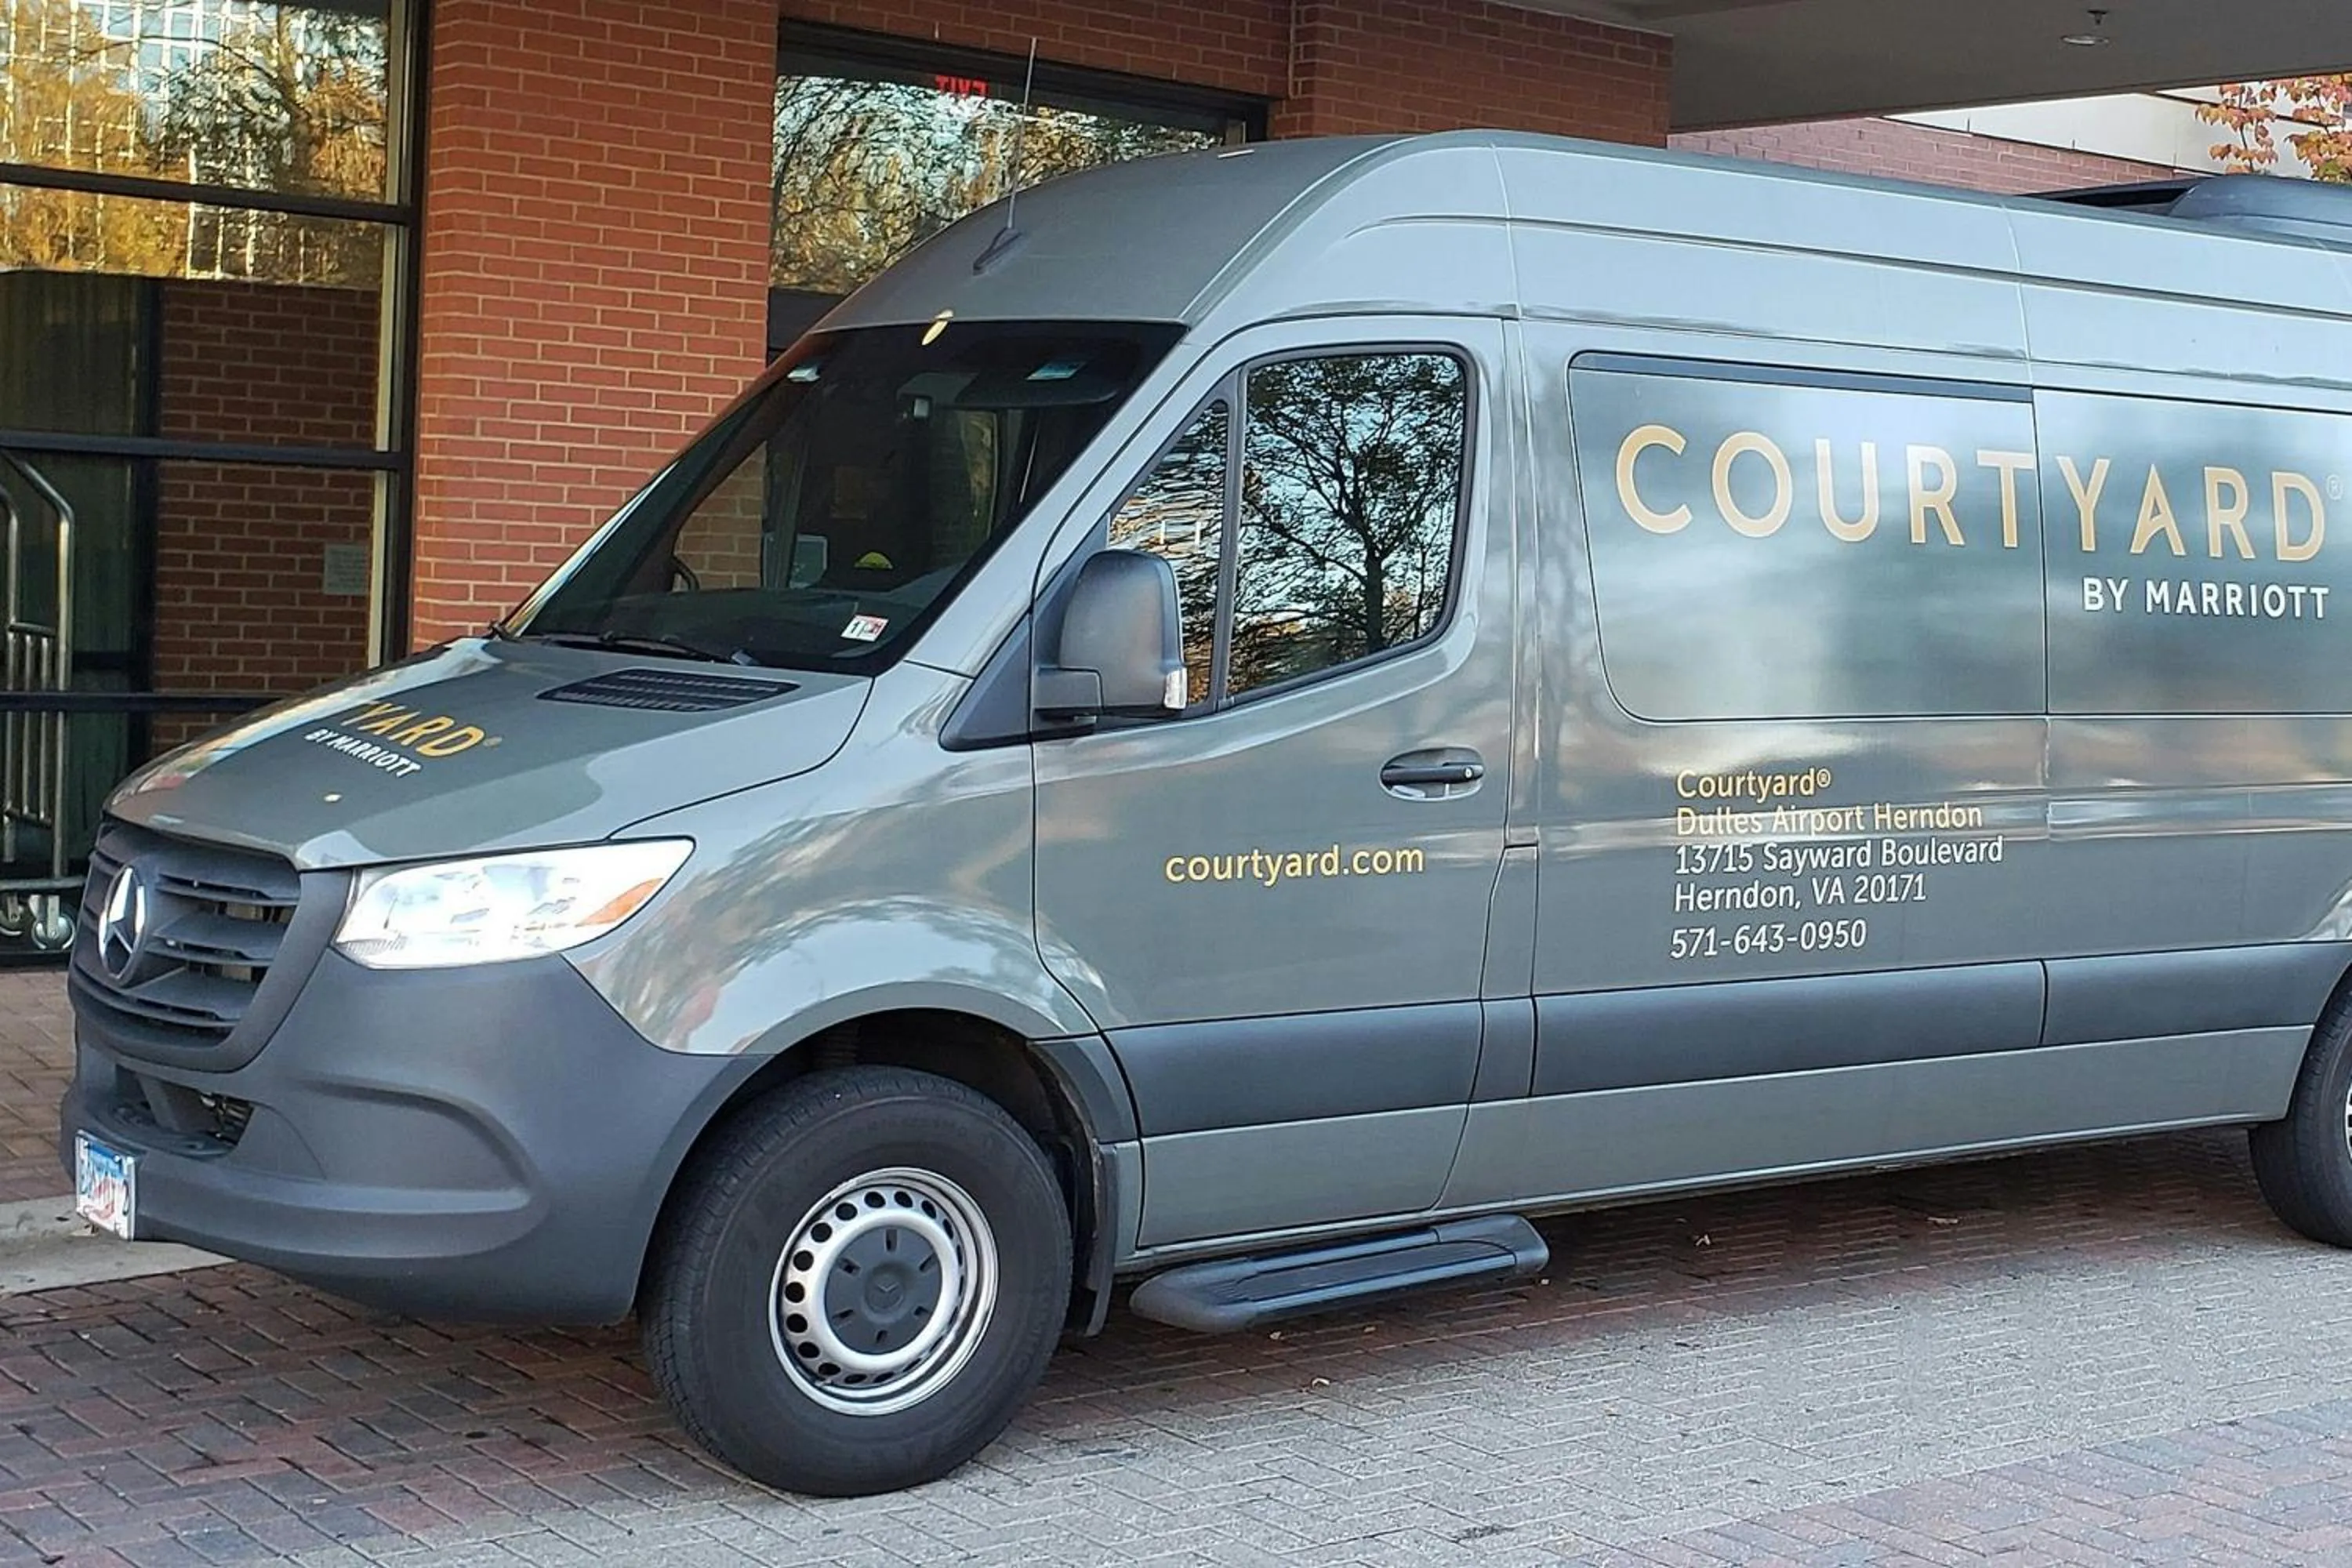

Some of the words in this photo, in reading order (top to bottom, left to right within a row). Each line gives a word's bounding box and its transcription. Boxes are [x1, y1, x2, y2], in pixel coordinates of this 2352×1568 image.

[2082, 577, 2129, 612] BY
[2145, 580, 2330, 619] MARRIOTT
[340, 702, 485, 757] YARD
[304, 729, 339, 743] BY
[326, 735, 422, 778] MARRIOTT
[1676, 807, 1762, 836] Dulles
[1771, 804, 1865, 840] Airport
[1874, 802, 1983, 831] Herndon
[1165, 844, 1424, 887] courtyard.com
[1675, 844, 1754, 874] 13715
[1762, 840, 1871, 877] Sayward
[1880, 836, 2004, 867] Boulevard
[1673, 879, 1802, 912] Herndon,
[1811, 877, 1845, 905] VA
[1853, 873, 1926, 904] 20171
[1670, 919, 1867, 959] 571-643-0950
